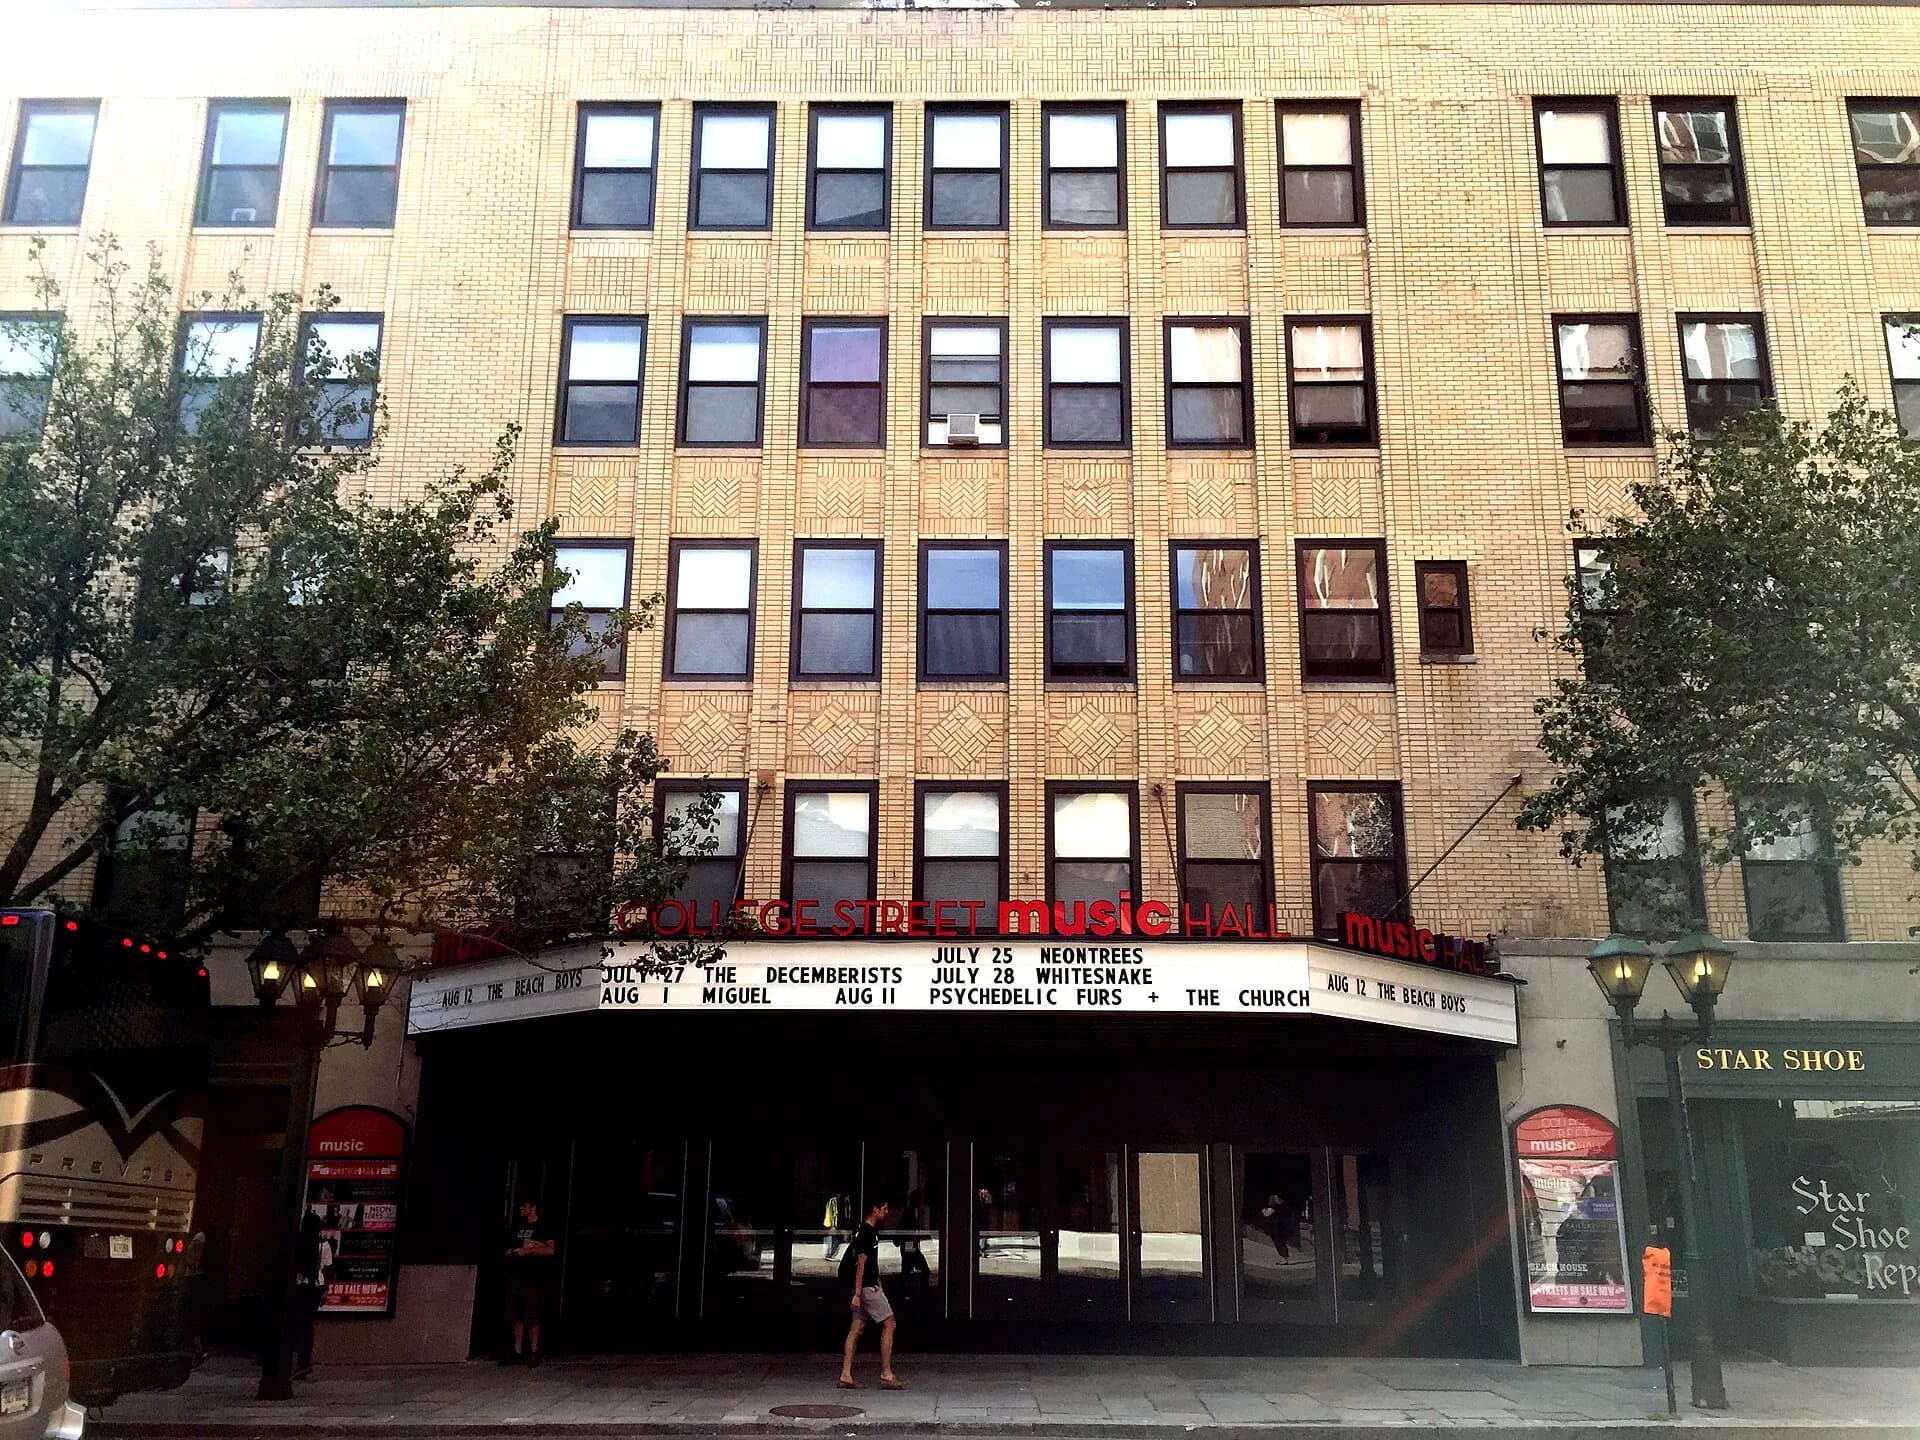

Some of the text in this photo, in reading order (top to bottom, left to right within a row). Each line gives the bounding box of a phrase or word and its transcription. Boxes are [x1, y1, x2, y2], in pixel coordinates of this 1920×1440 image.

[832, 900, 985, 936] STREET
[998, 890, 1172, 936] music
[1184, 901, 1291, 939] HALL
[1344, 911, 1436, 961] music
[932, 947, 1143, 965] JULY 25 NEONTREES
[601, 965, 903, 984] JULY 27 THE DECEMBERISTS
[931, 967, 1153, 986] JULY 28 WHITESNAKE
[442, 970, 582, 1008] AUG 12 THE BEACH BOYS
[601, 986, 640, 1004] AUG
[702, 987, 771, 1004] MIGUEL
[835, 987, 873, 1005] AUG
[930, 987, 1058, 1006] PSYCHEDELIC
[1076, 988, 1122, 1006] FURS
[1186, 988, 1220, 1006] THE
[1238, 989, 1310, 1007] CHURCH
[1327, 973, 1466, 1013] AUG 12 THE BEACH BOYS
[1696, 1048, 1866, 1071] STAR SHOE
[319, 1138, 366, 1152] music
[1530, 1138, 1577, 1151] music
[1791, 1175, 1871, 1215] Star
[1831, 1214, 1910, 1251] Shoe
[1559, 1263, 1588, 1272] HOUSE
[1862, 1253, 1920, 1295] Rep
[344, 1284, 360, 1295] SALE
[1580, 1285, 1598, 1296] SALE
